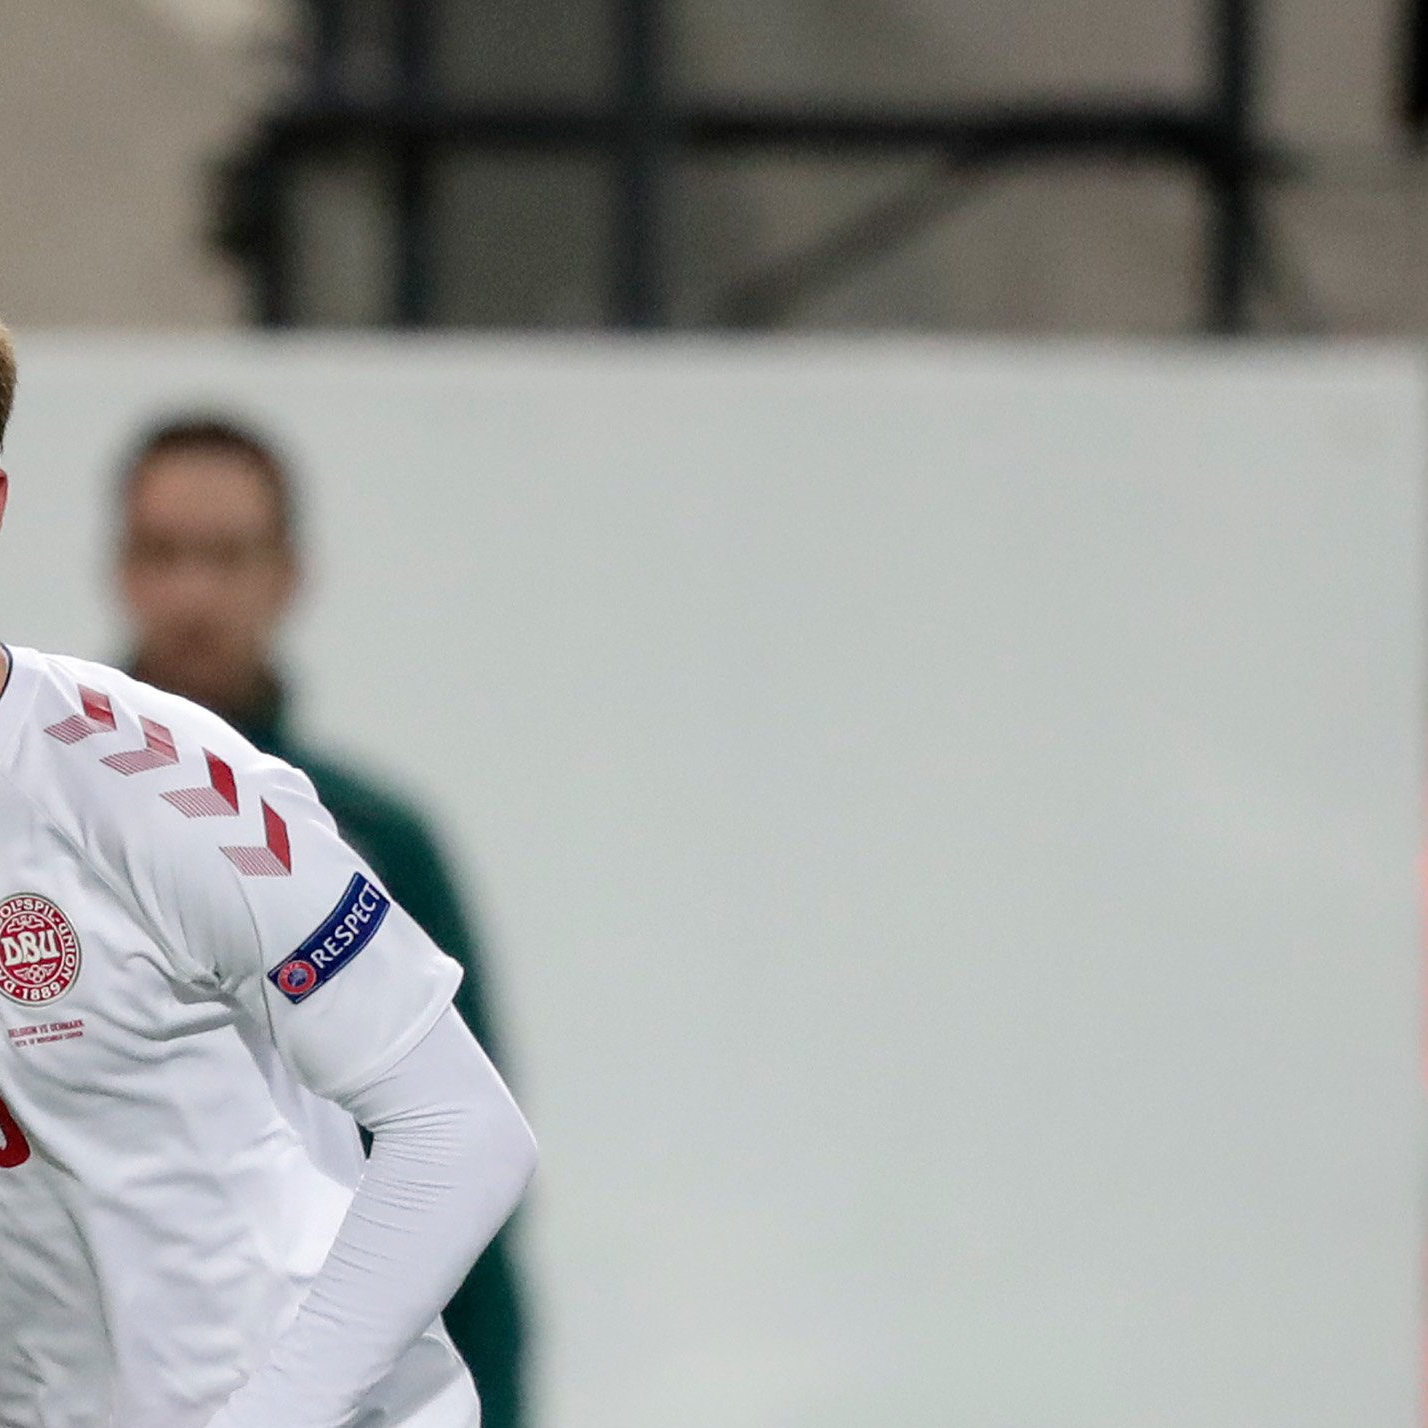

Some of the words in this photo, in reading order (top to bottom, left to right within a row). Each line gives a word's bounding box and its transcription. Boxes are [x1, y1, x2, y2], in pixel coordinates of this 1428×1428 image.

[309, 881, 381, 969] RESPECT
[1, 929, 61, 966] DBU
[22, 981, 61, 1001] 1889
